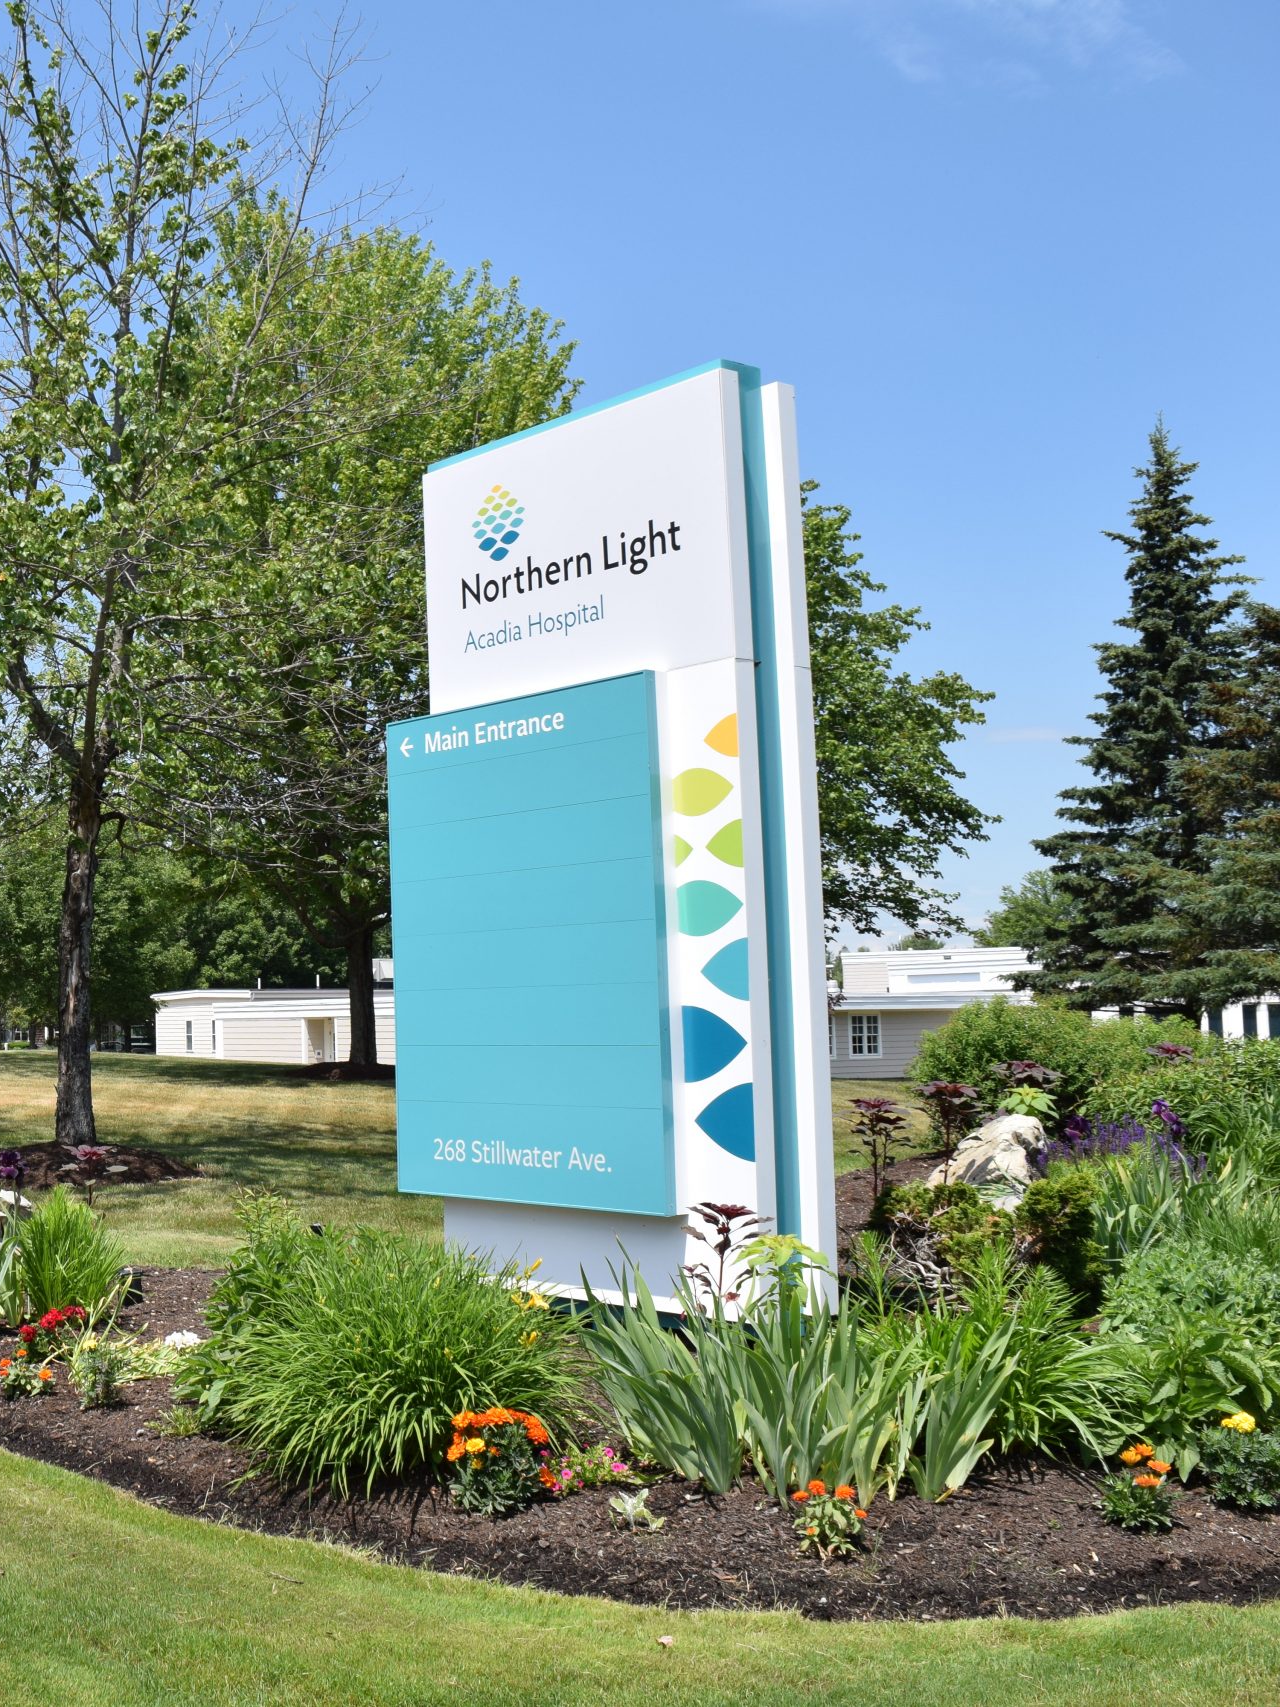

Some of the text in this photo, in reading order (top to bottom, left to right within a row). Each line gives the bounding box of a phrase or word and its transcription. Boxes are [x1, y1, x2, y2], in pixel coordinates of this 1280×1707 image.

[461, 520, 681, 610] Northern Light
[464, 595, 605, 653] Acadia Hospital
[424, 711, 565, 754] Main Entrance
[433, 1138, 613, 1173] 268 Stillwater Ave.
